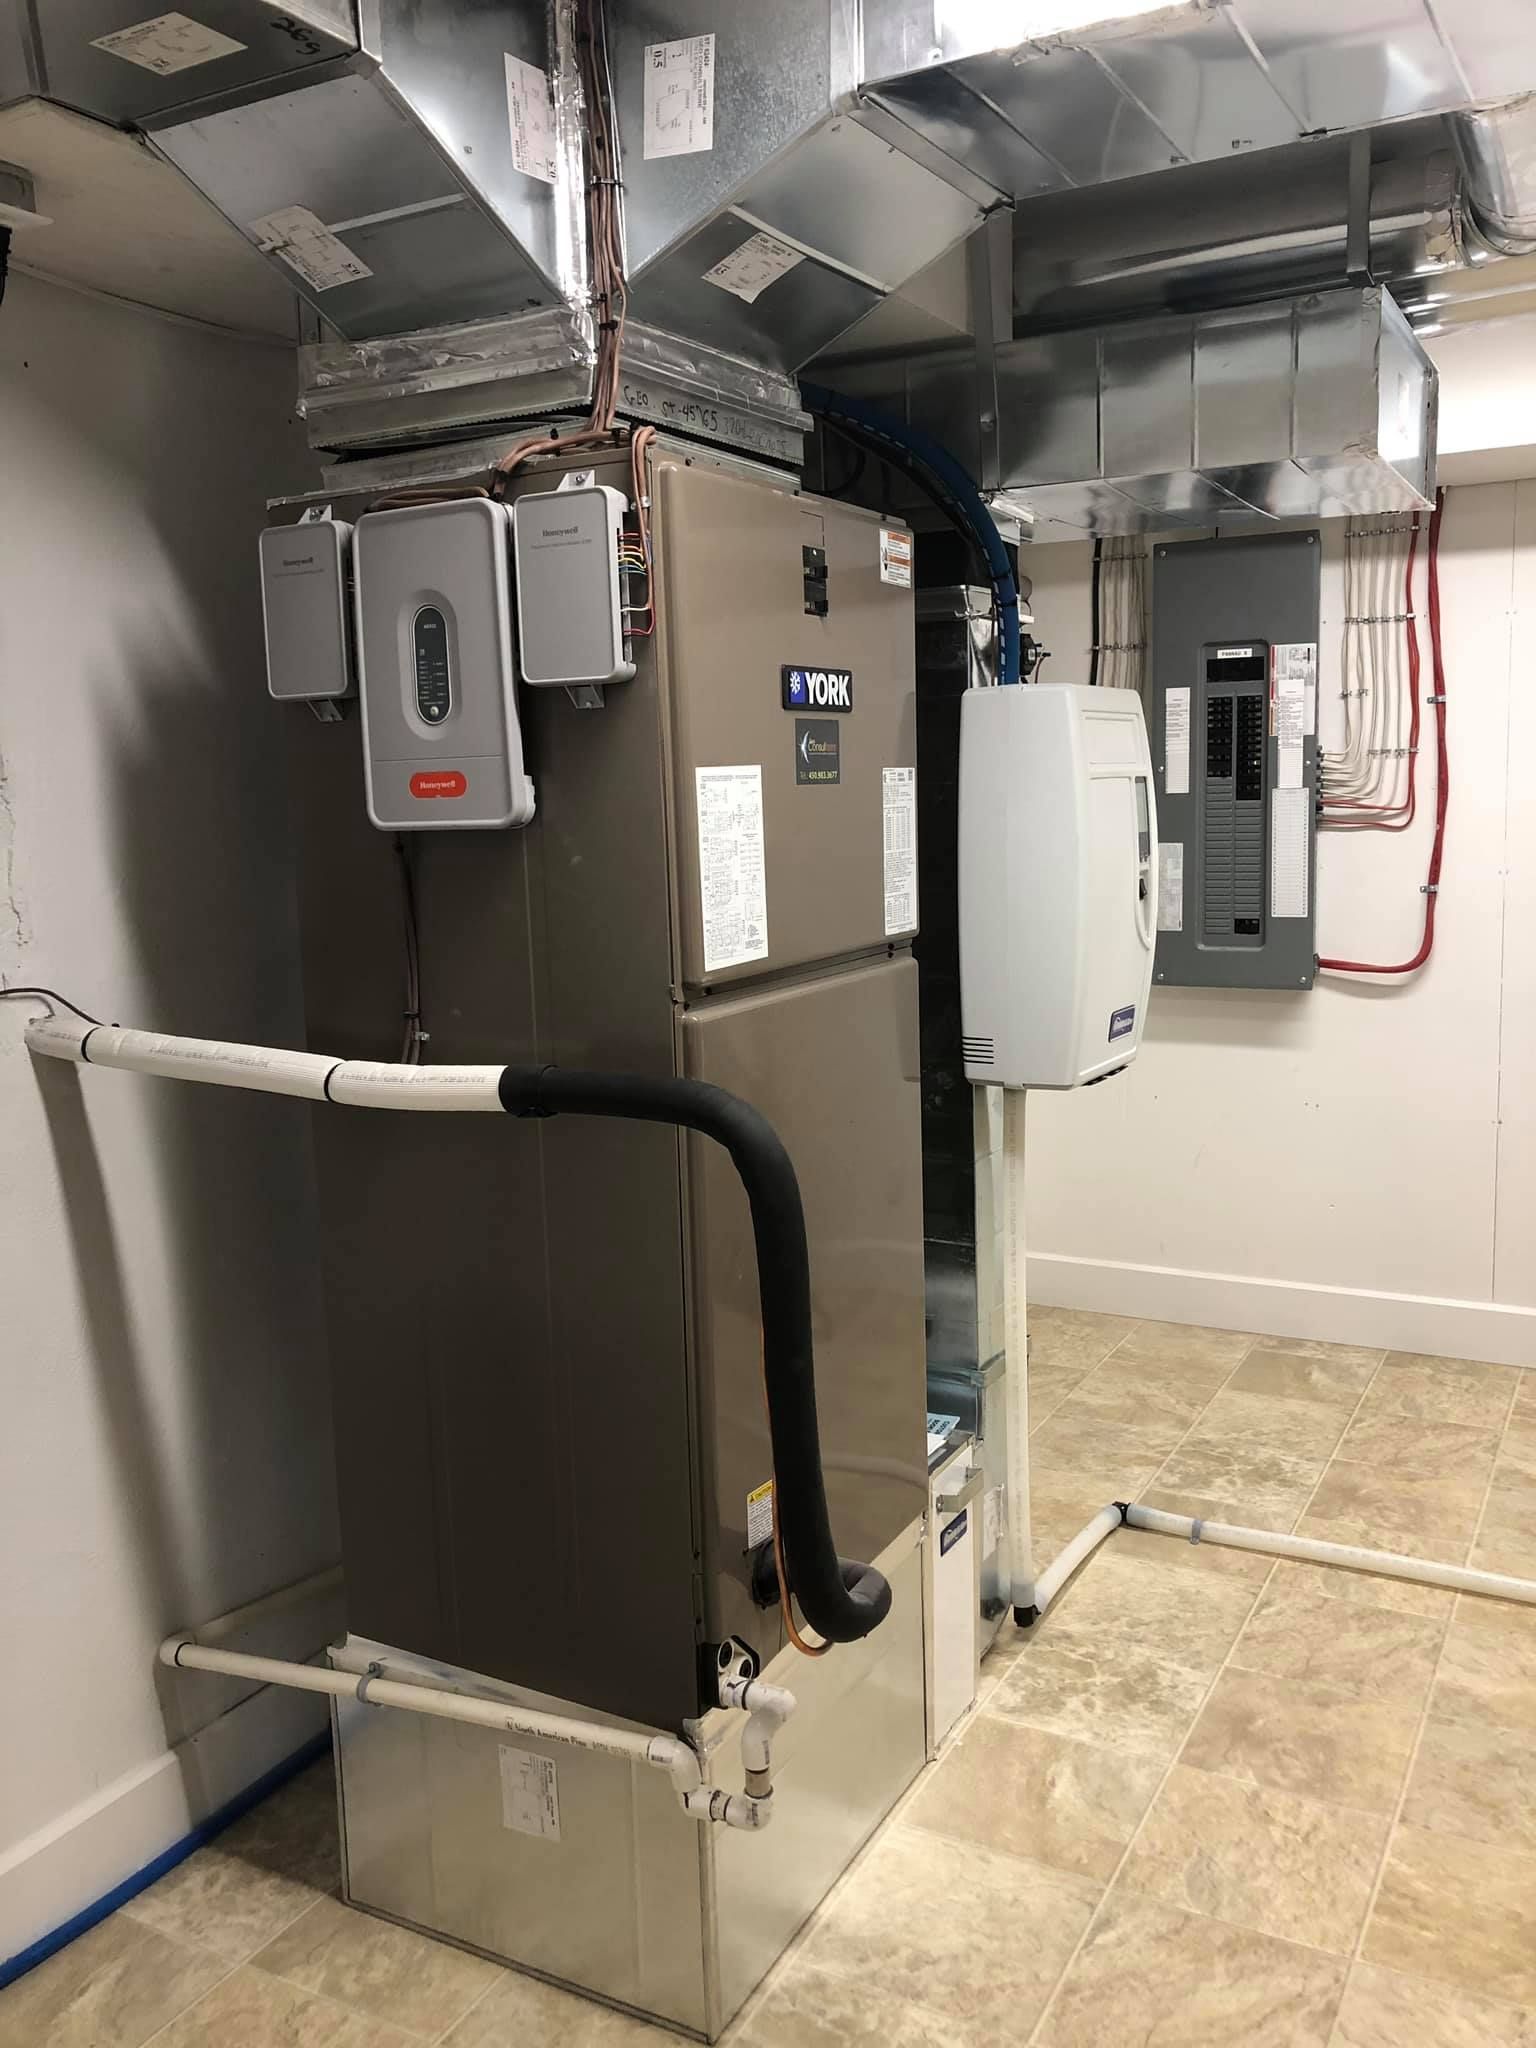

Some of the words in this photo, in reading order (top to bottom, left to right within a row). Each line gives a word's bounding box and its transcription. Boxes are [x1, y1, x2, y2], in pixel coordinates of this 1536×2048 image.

[542, 526, 579, 537] Honeywell
[804, 671, 850, 706] YORK
[419, 780, 456, 790] Honeywell
[536, 1728, 570, 1744] American
